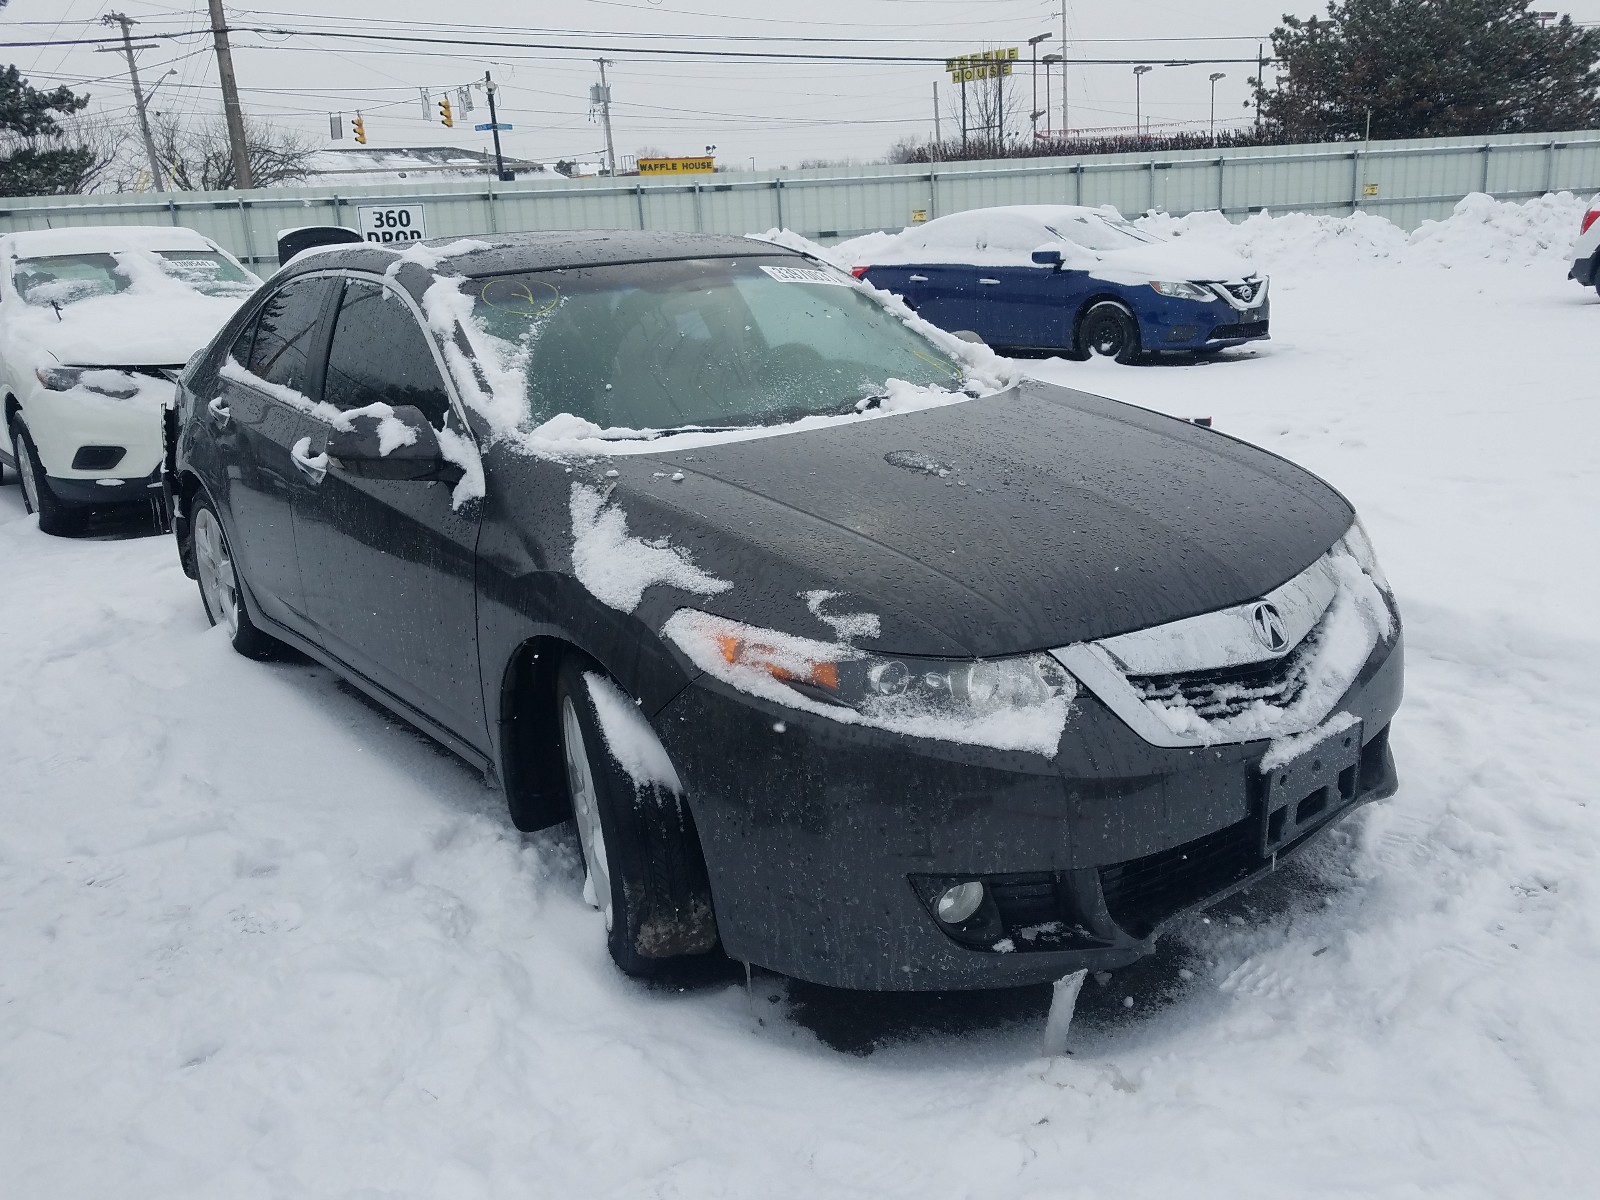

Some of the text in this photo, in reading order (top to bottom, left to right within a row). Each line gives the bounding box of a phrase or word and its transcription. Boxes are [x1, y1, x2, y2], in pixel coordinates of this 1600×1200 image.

[953, 64, 1010, 82] HOUSE
[640, 161, 712, 171] WAFFLE HOUSE
[372, 209, 411, 228] 360
